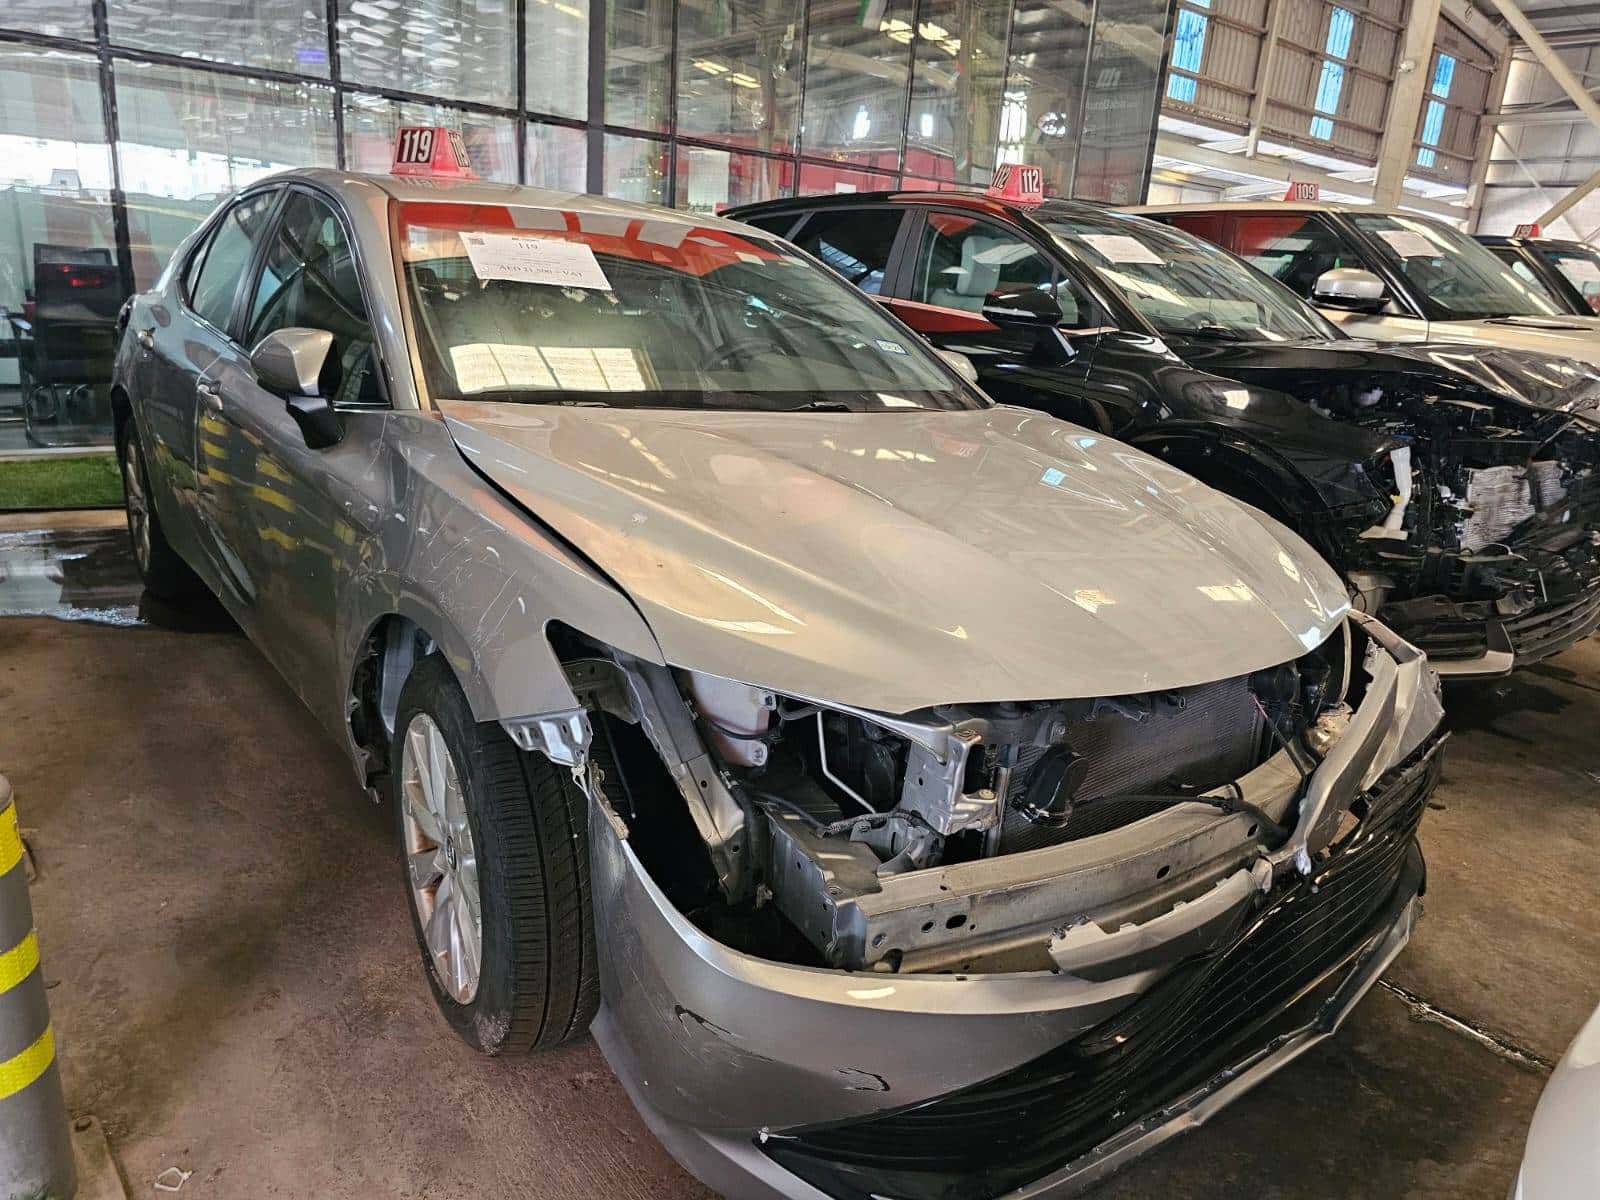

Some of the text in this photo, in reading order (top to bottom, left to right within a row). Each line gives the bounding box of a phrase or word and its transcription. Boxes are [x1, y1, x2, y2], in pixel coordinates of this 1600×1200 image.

[401, 129, 433, 163] 119
[1022, 169, 1041, 193] 112
[1297, 183, 1315, 199] 109
